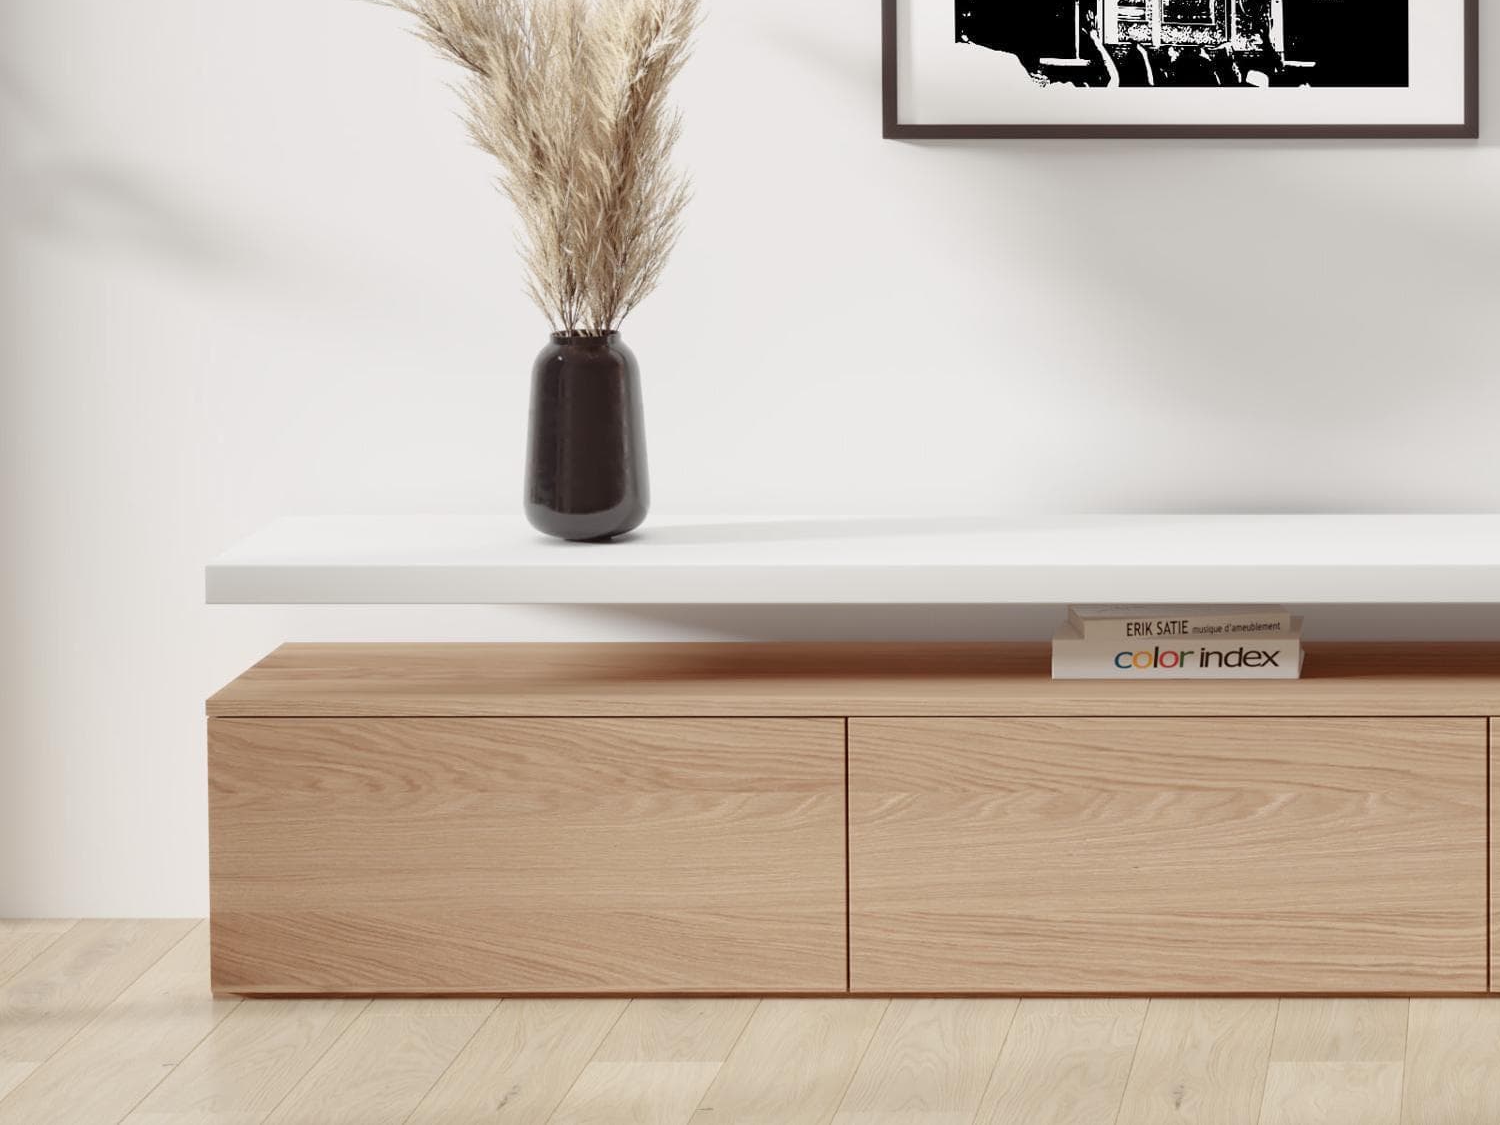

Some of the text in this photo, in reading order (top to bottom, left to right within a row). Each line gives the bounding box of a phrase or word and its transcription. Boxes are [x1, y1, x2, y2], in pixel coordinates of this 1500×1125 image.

[1126, 622, 1154, 637] ERIK
[1156, 620, 1189, 636] SATIE
[1192, 625, 1222, 635] musique
[1114, 646, 1280, 669] color index
